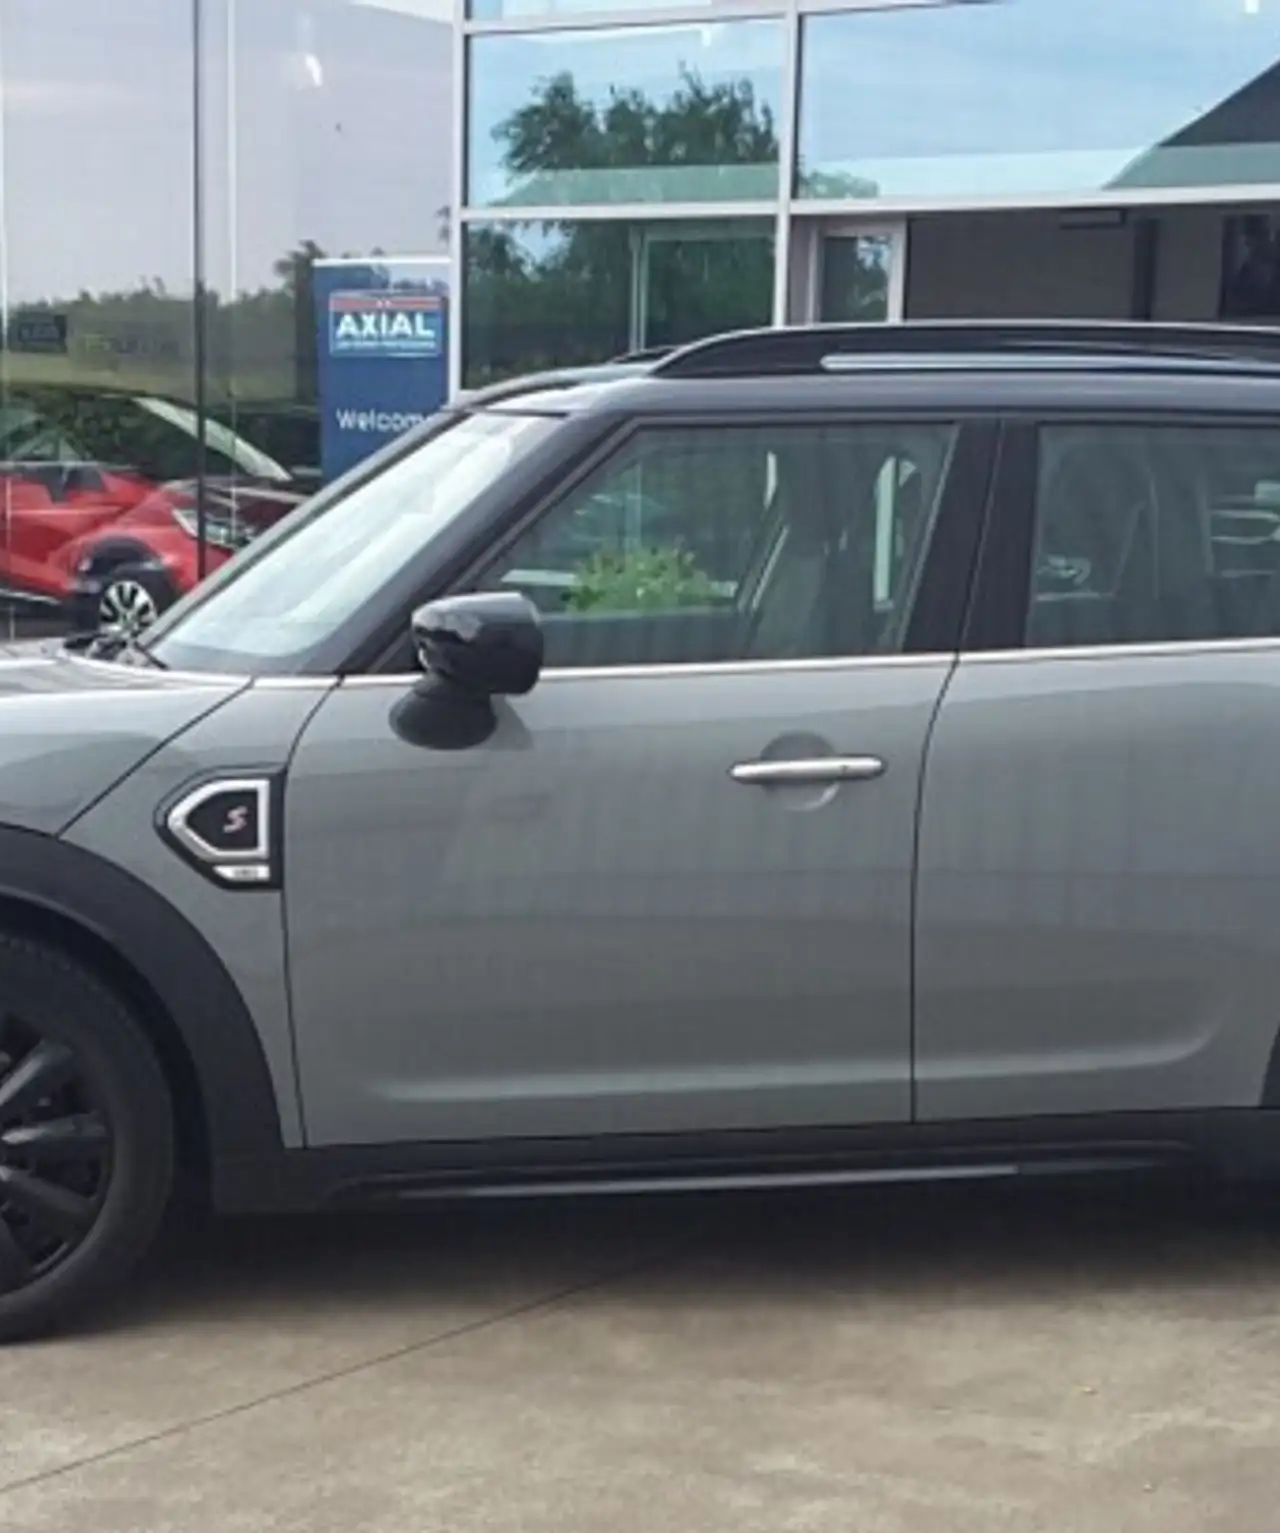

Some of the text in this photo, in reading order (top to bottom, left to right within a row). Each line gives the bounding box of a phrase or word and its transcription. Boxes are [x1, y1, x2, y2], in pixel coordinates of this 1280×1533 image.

[336, 312, 436, 338] AXIAL
[336, 408, 429, 432] Welcom
[223, 806, 248, 833] S
